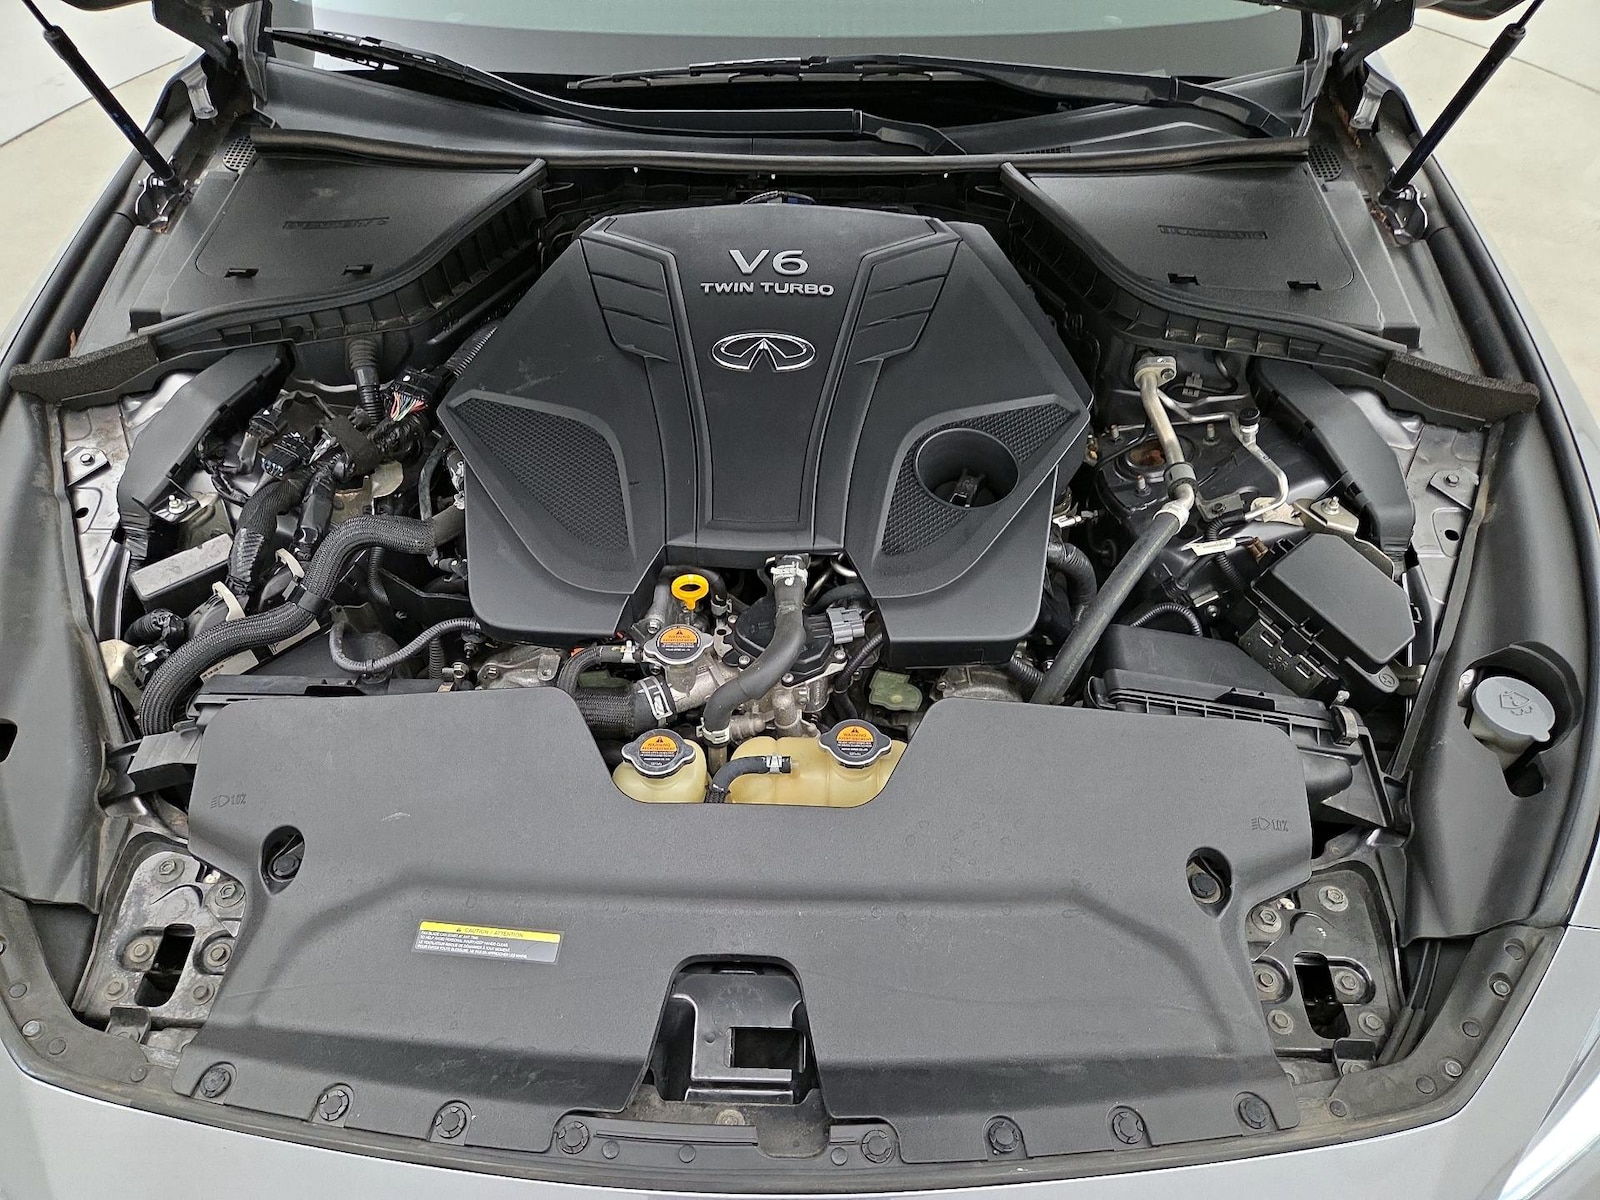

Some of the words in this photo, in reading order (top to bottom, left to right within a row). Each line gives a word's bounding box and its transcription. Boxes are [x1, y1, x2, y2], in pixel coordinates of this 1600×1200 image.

[729, 250, 809, 276] V6
[700, 282, 754, 294] TWIN
[760, 282, 835, 296] TURBO
[494, 930, 524, 938] ATTENTION
